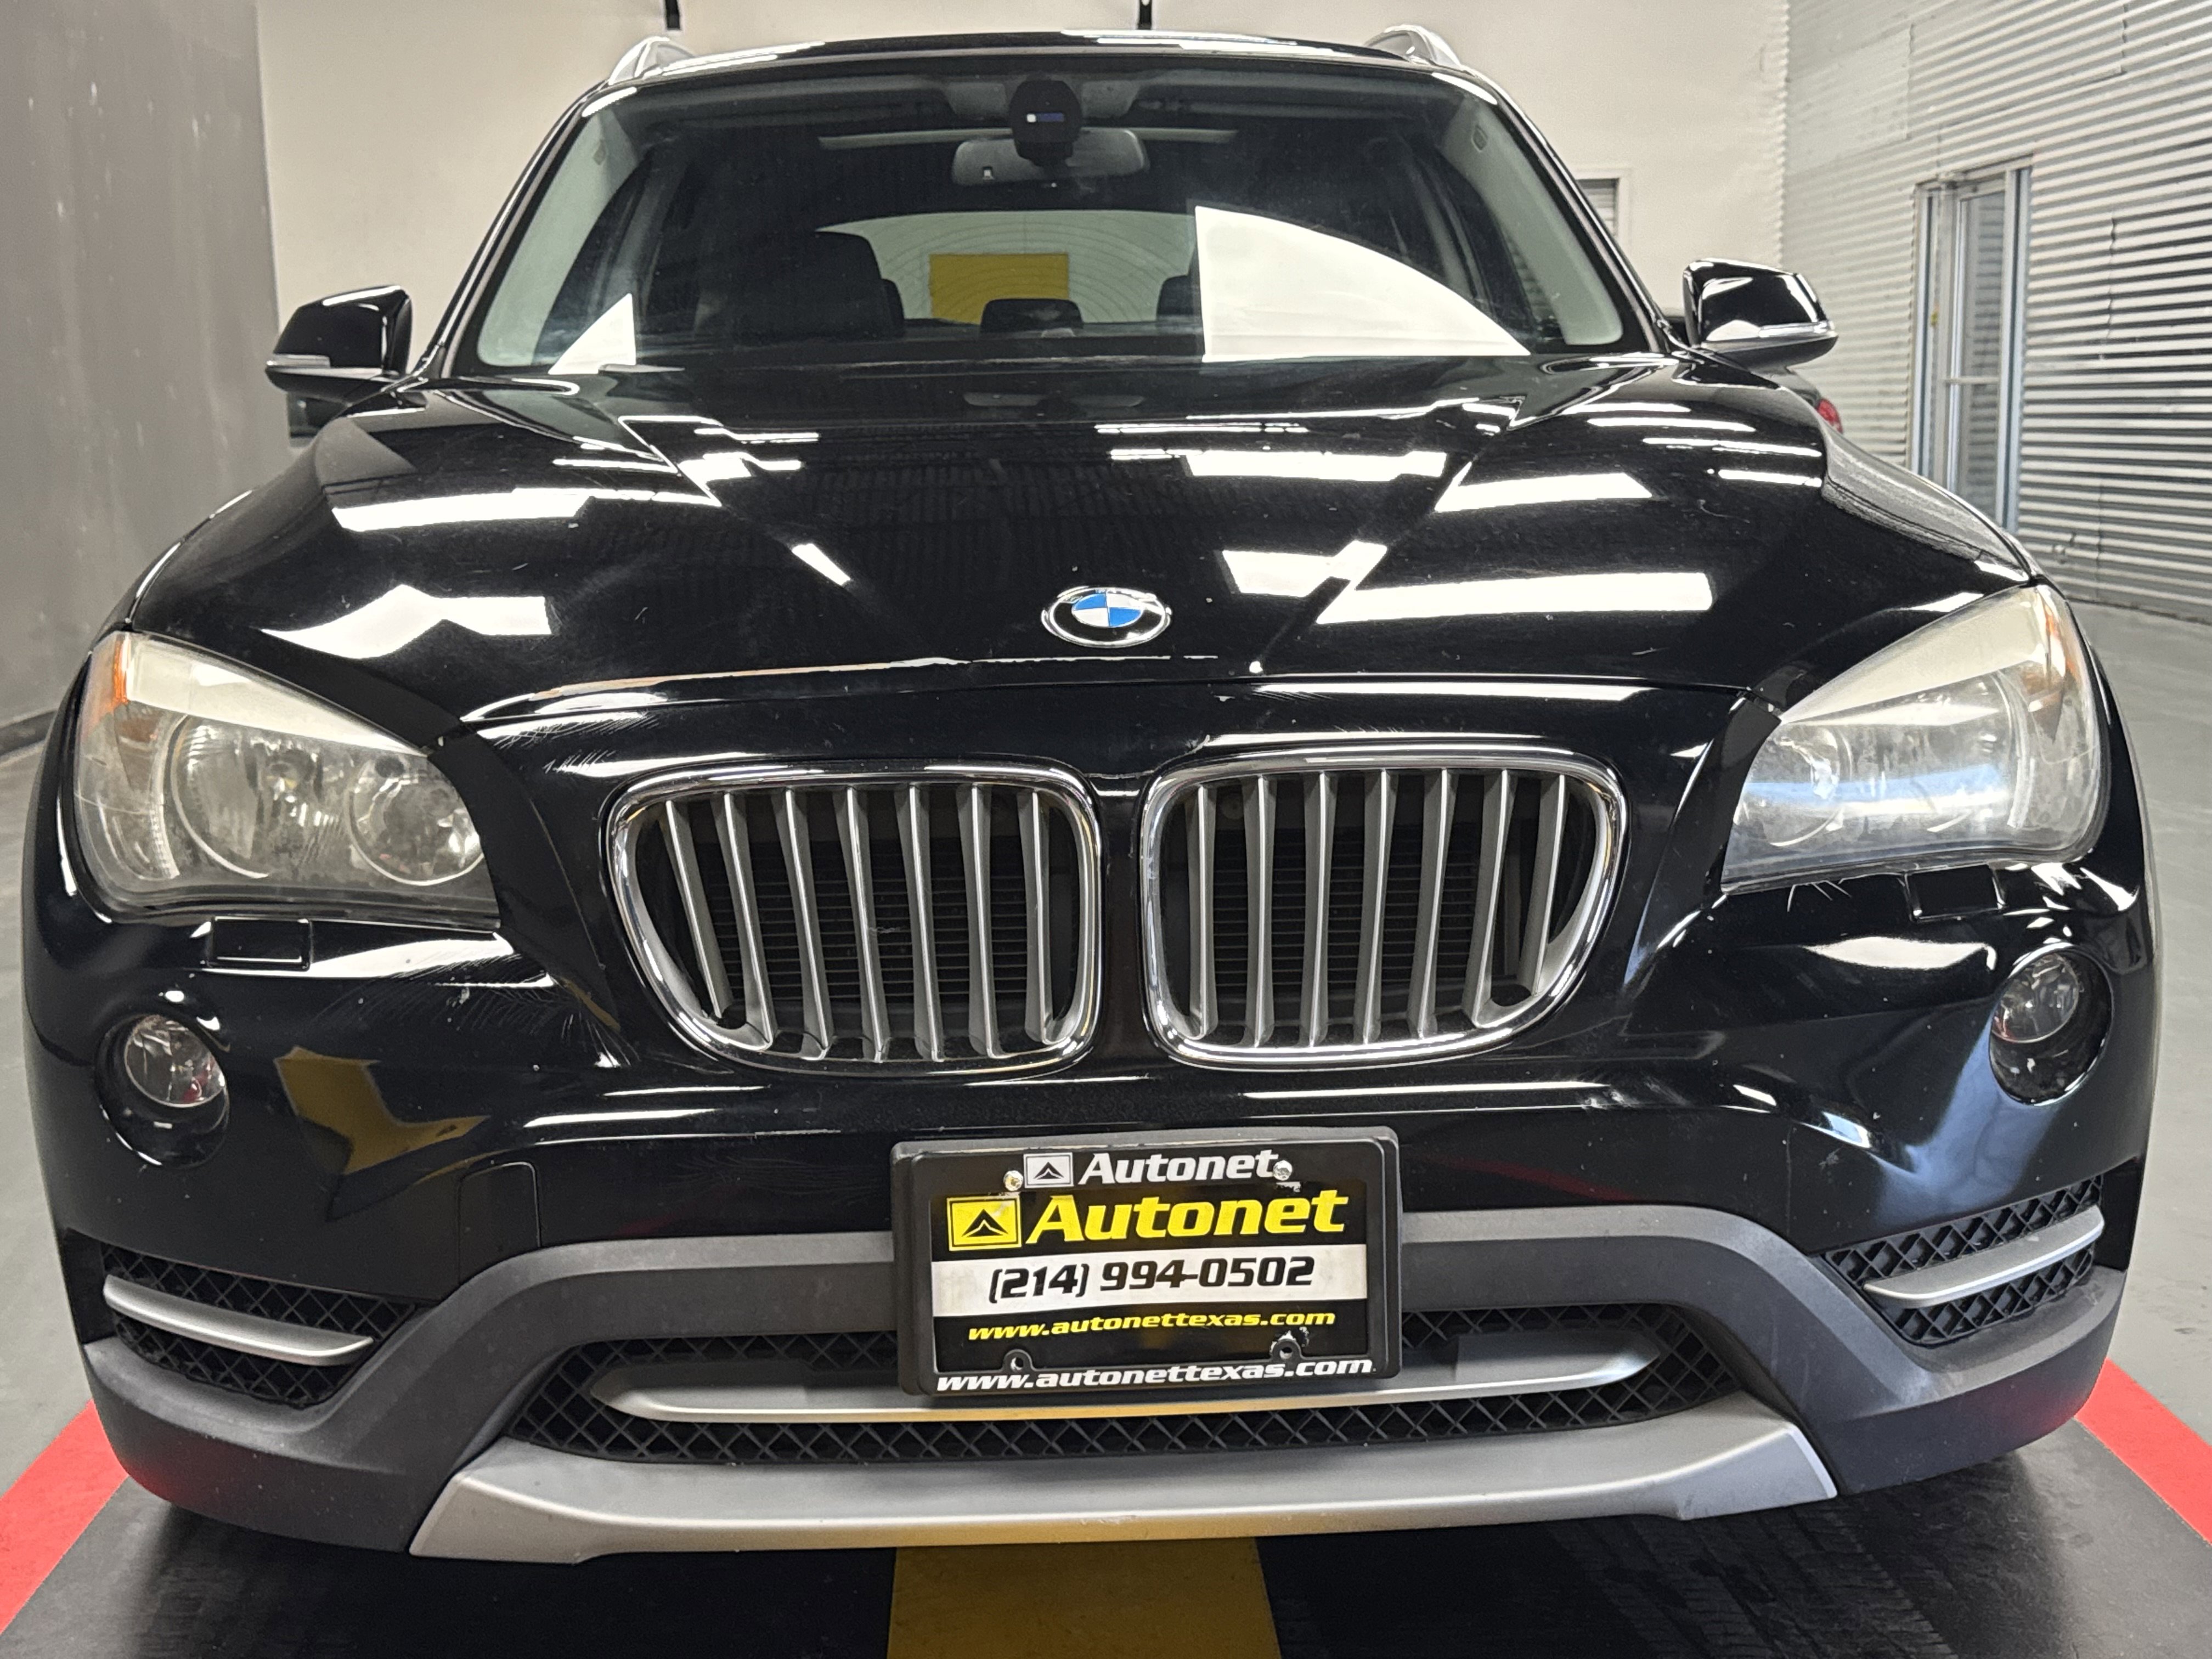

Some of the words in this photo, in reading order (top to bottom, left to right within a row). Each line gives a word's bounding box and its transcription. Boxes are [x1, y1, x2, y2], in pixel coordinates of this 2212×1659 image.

[1078, 1150, 1279, 1185] Autonet
[1025, 1189, 1349, 1244] Autonet
[989, 1263, 1090, 1304] (214)
[1100, 1256, 1315, 1291] 994-0502
[968, 1313, 1335, 1340] www.autonettexas.com
[936, 1359, 1373, 1391] www.autonettexas.com
